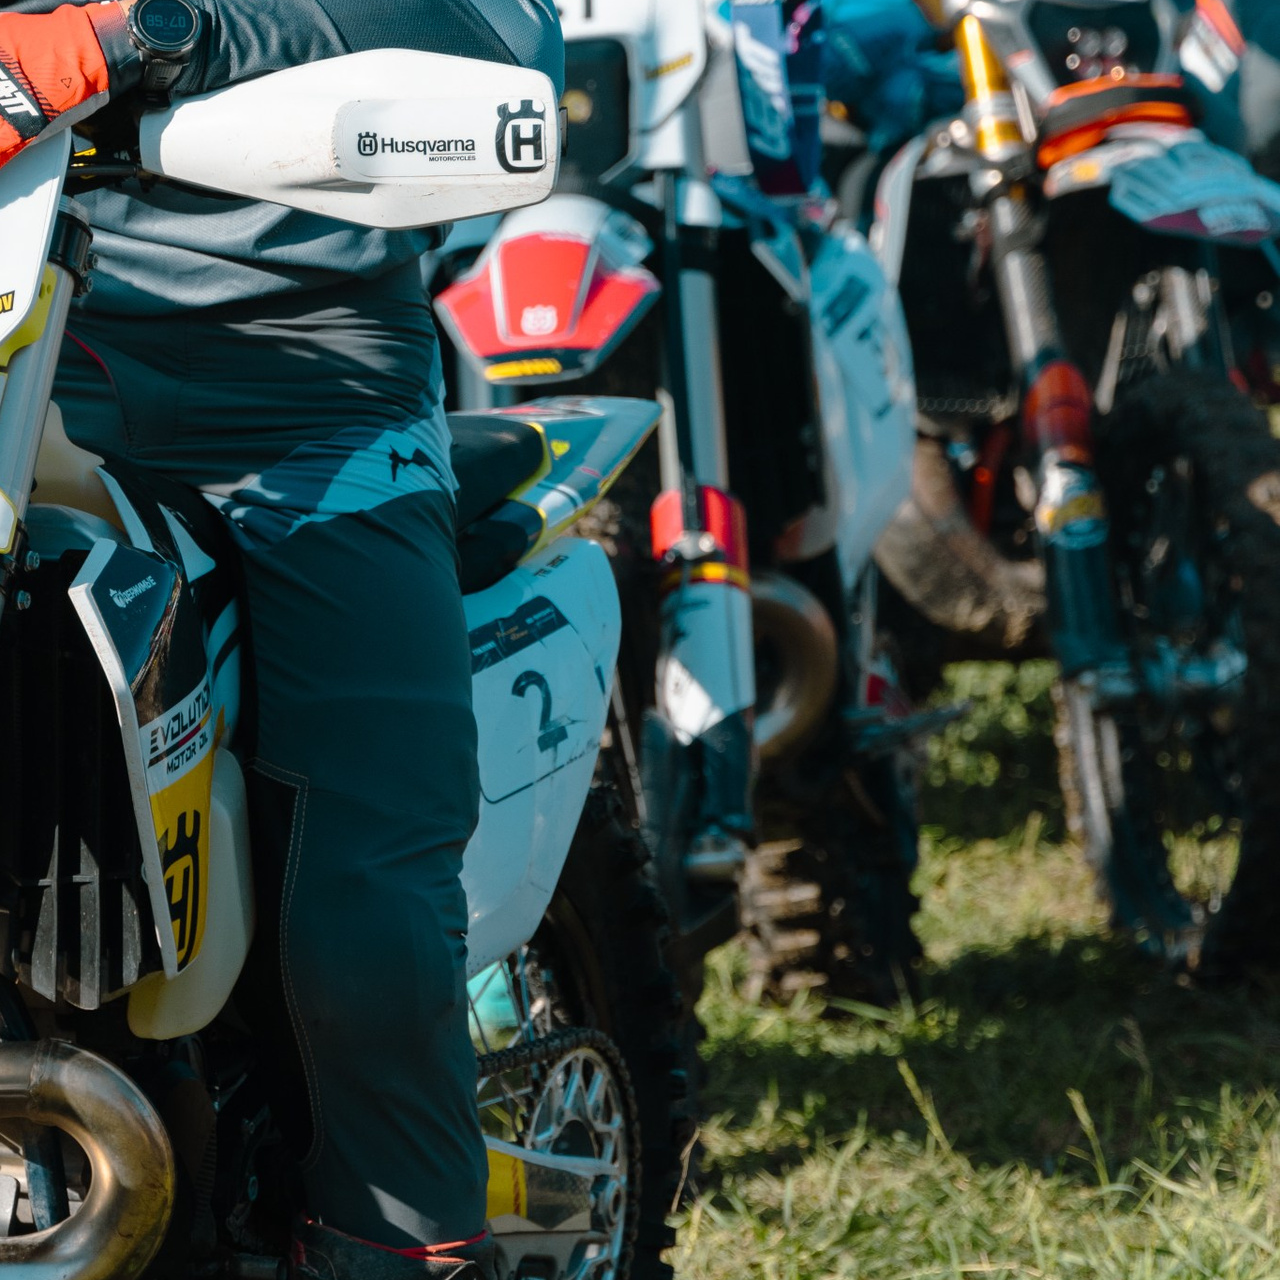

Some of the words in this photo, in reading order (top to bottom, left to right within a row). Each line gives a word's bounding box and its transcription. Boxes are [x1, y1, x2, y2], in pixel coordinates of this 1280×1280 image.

[381, 137, 476, 156] Husqvarna
[428, 155, 477, 163] MOTORCYCLES
[511, 669, 569, 753] 2
[166, 742, 197, 775] MOTOR
